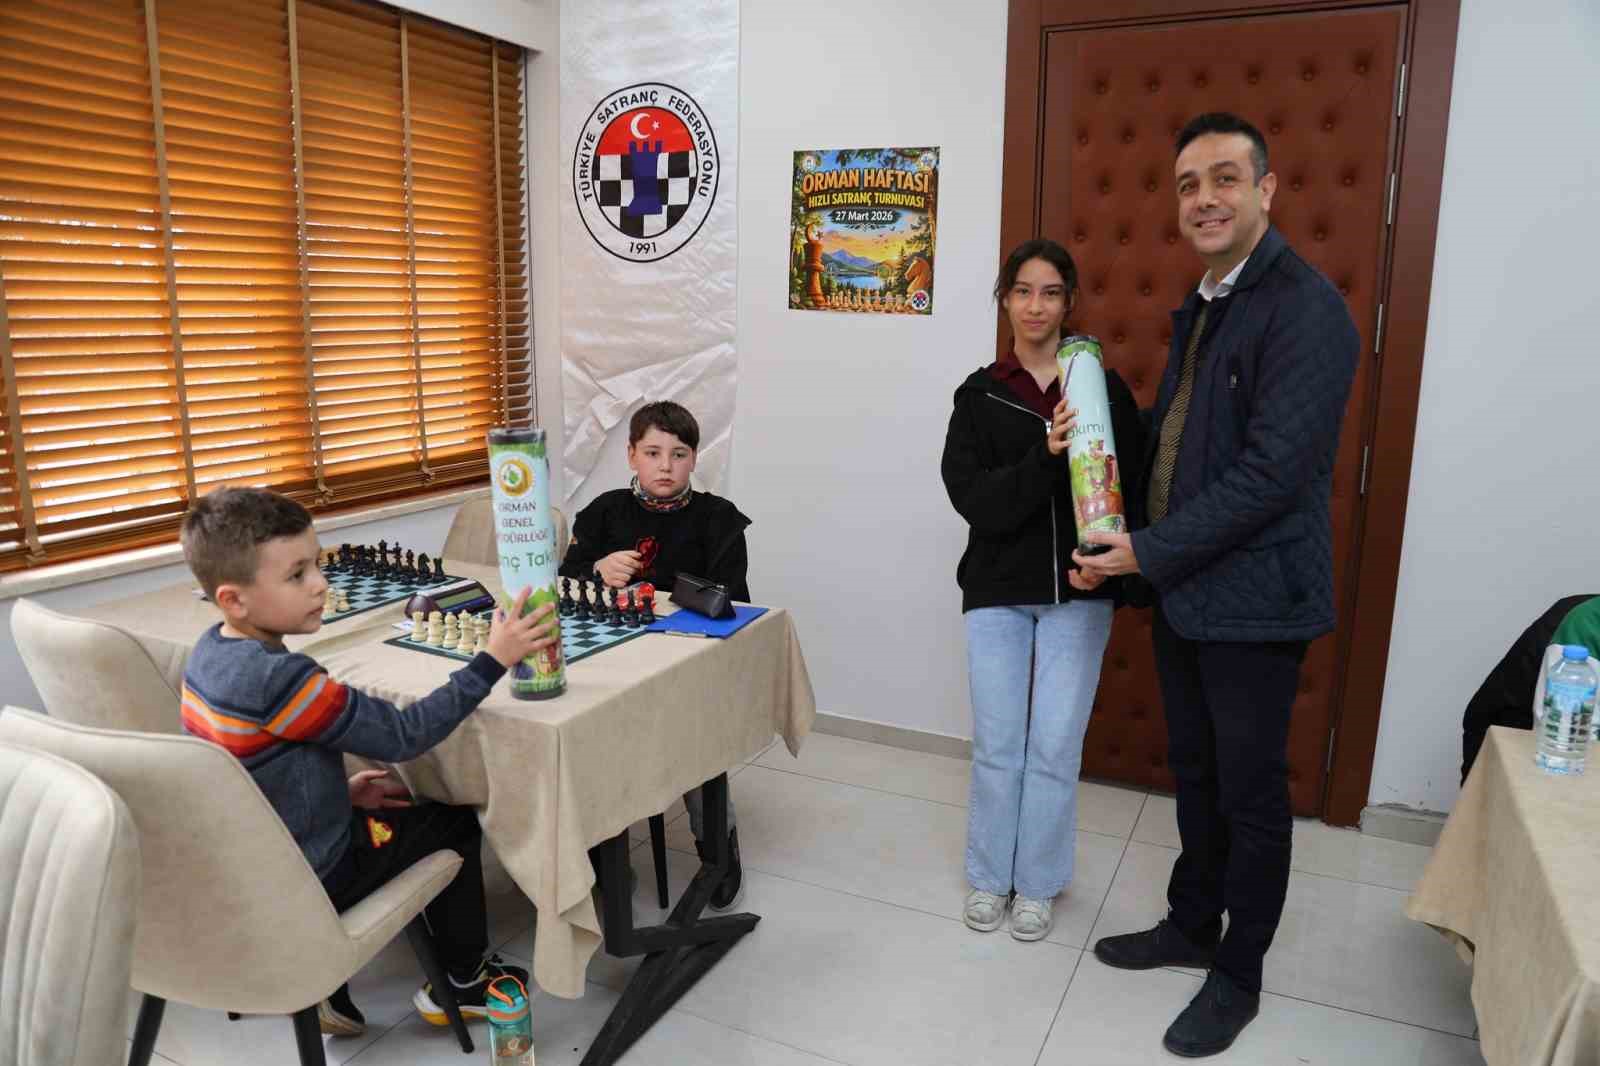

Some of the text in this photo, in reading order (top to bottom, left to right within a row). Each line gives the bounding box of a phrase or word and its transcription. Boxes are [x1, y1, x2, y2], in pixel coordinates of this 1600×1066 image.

[579, 90, 713, 202] TÜRKİYE SATRANÇ FEDERASYONU
[802, 169, 929, 194] ORMAN HAFTASI
[808, 192, 925, 208] HIZLI SATRANÇ TURNUVASI
[835, 211, 894, 221] 27 Mart 2026
[629, 242, 657, 254] 1991
[502, 518, 535, 528] GENEL
